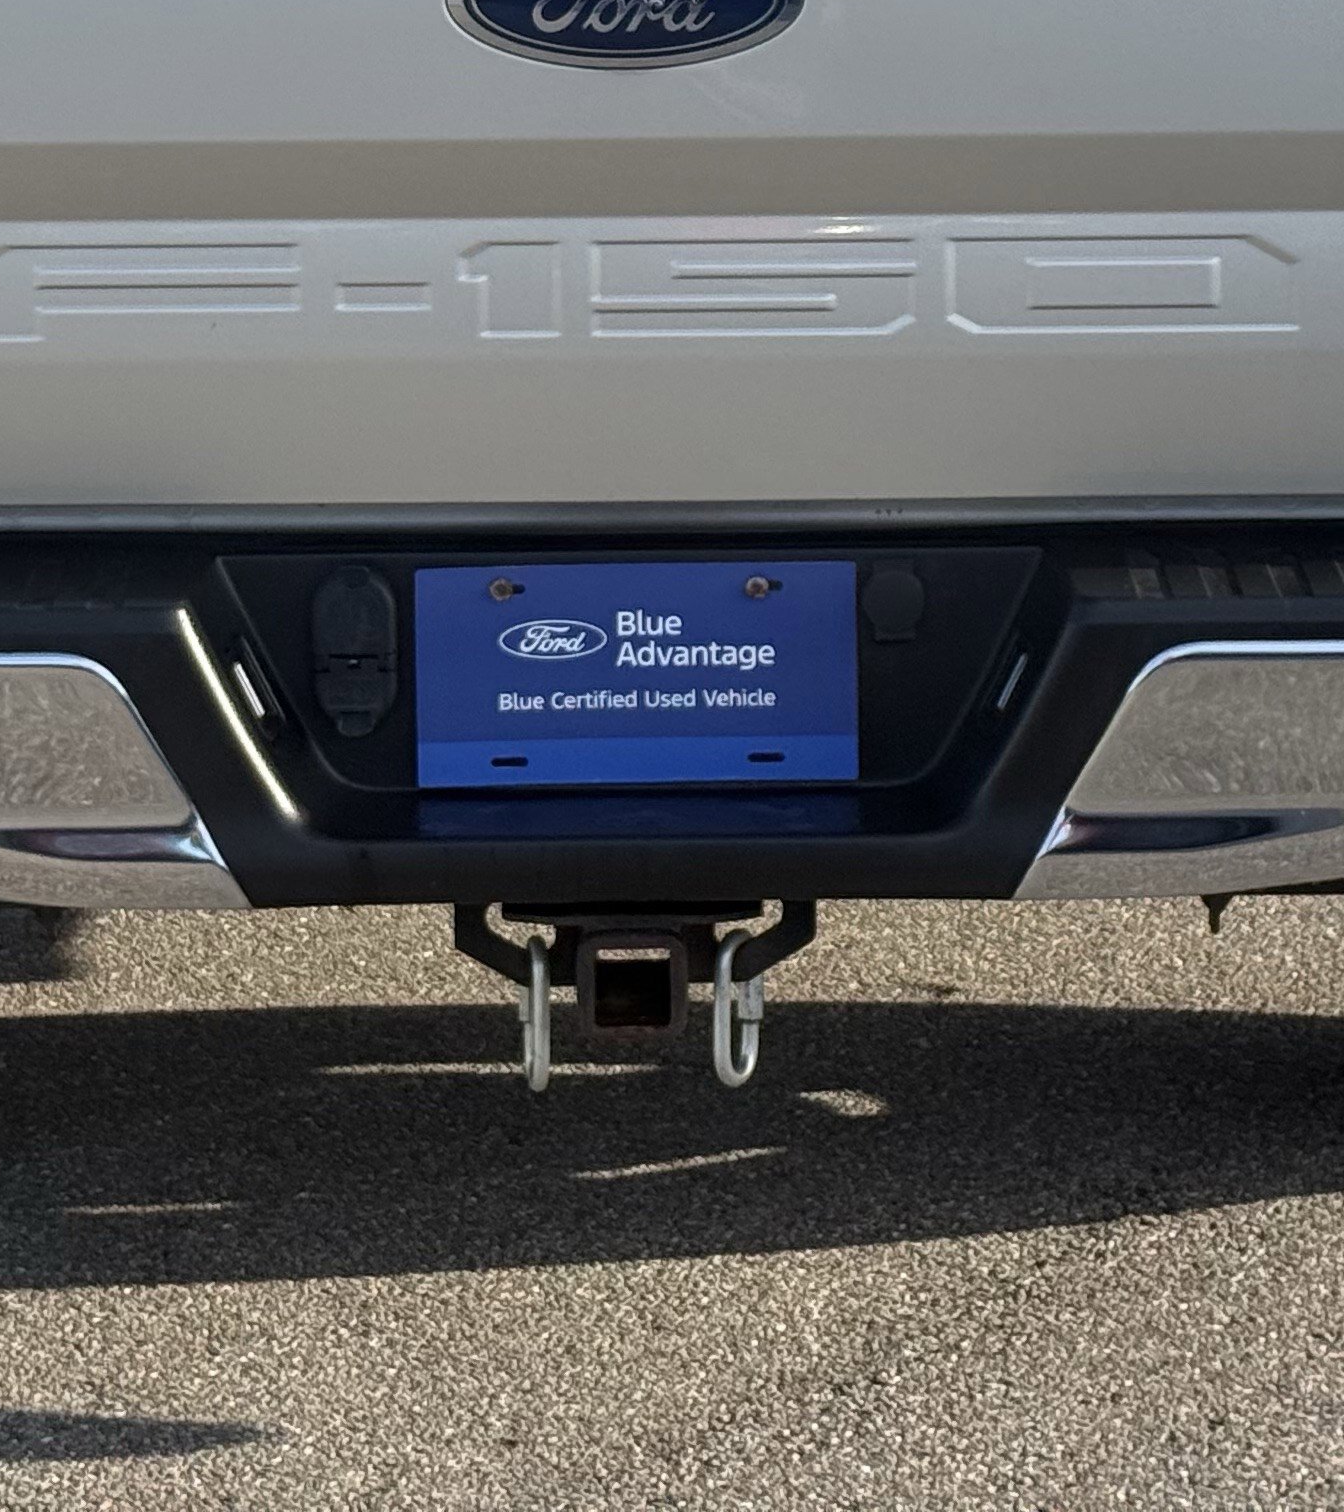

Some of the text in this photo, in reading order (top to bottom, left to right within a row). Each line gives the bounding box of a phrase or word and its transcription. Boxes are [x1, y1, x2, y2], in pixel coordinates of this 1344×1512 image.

[616, 609, 683, 636] Blue
[519, 625, 586, 653] Ford
[615, 640, 776, 671] Advantage
[499, 688, 777, 711] Blue Certified Used Vehicle
